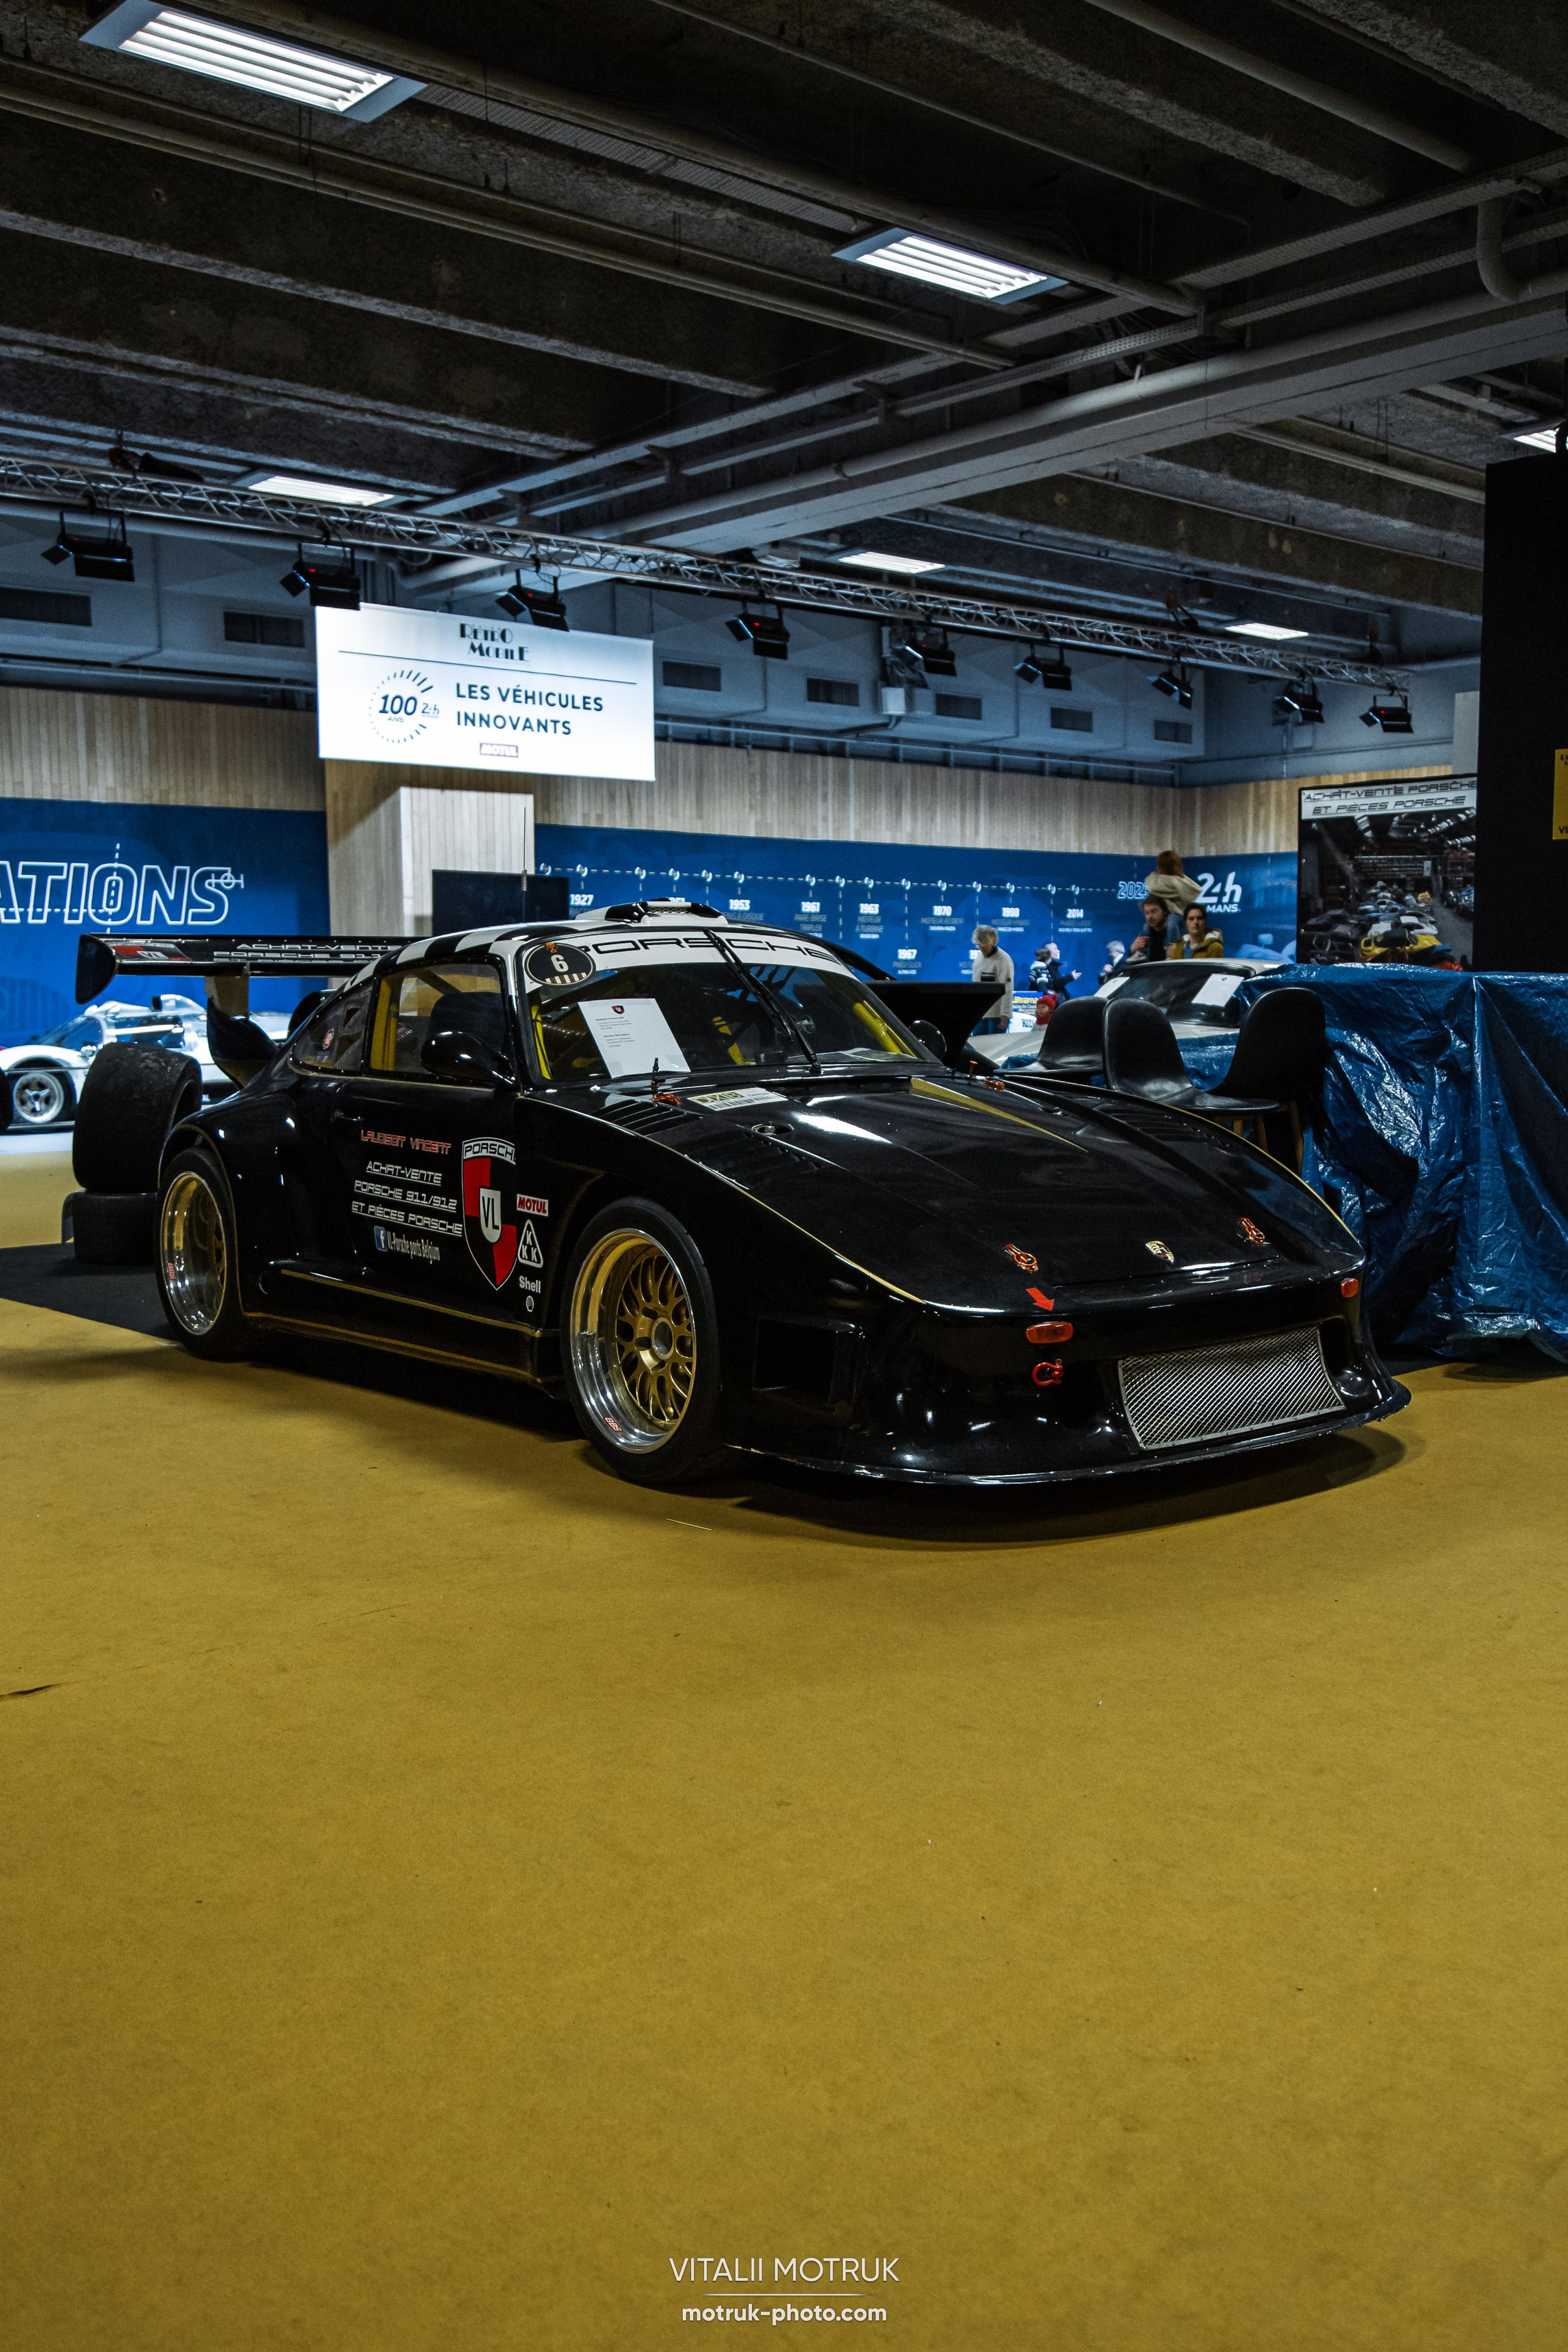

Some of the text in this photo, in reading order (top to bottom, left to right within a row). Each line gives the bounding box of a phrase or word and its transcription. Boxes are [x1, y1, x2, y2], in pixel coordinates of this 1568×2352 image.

[469, 641, 530, 662] MOBILE
[379, 693, 418, 715] 100
[456, 682, 603, 712] LES VÉHICULES
[456, 711, 571, 735] INNOVANTS
[481, 744, 518, 757] MOTUL
[1408, 780, 1477, 793] PORSCHE
[1313, 805, 1332, 815] ET
[1393, 796, 1466, 809] PORSCHE
[570, 894, 594, 905] 1927
[729, 899, 750, 910] 1953
[801, 902, 821, 913] 1961
[859, 903, 880, 914] 1963
[1207, 903, 1238, 913] MANS
[933, 905, 952, 916] 1970
[1066, 908, 1084, 918] 2014
[579, 937, 840, 964] ORSCHE
[897, 949, 918, 960] 1967
[551, 954, 569, 973] 6
[692, 1091, 744, 1104] DXB
[410, 1137, 451, 1155] VINCENT
[464, 1143, 516, 1162] PORSCH
[366, 1161, 442, 1184] ACHAT-VENTE
[354, 1180, 458, 1211] PORSCHE 911/912
[482, 1196, 500, 1231] VL
[518, 1196, 548, 1214] MOTUL
[352, 1200, 463, 1234] ET PIÈCES PORSCHE
[410, 1239, 422, 1259] parts
[421, 1238, 440, 1264] Belgium
[519, 1275, 541, 1294] Shell
[604, 1417, 623, 1432] BBS
